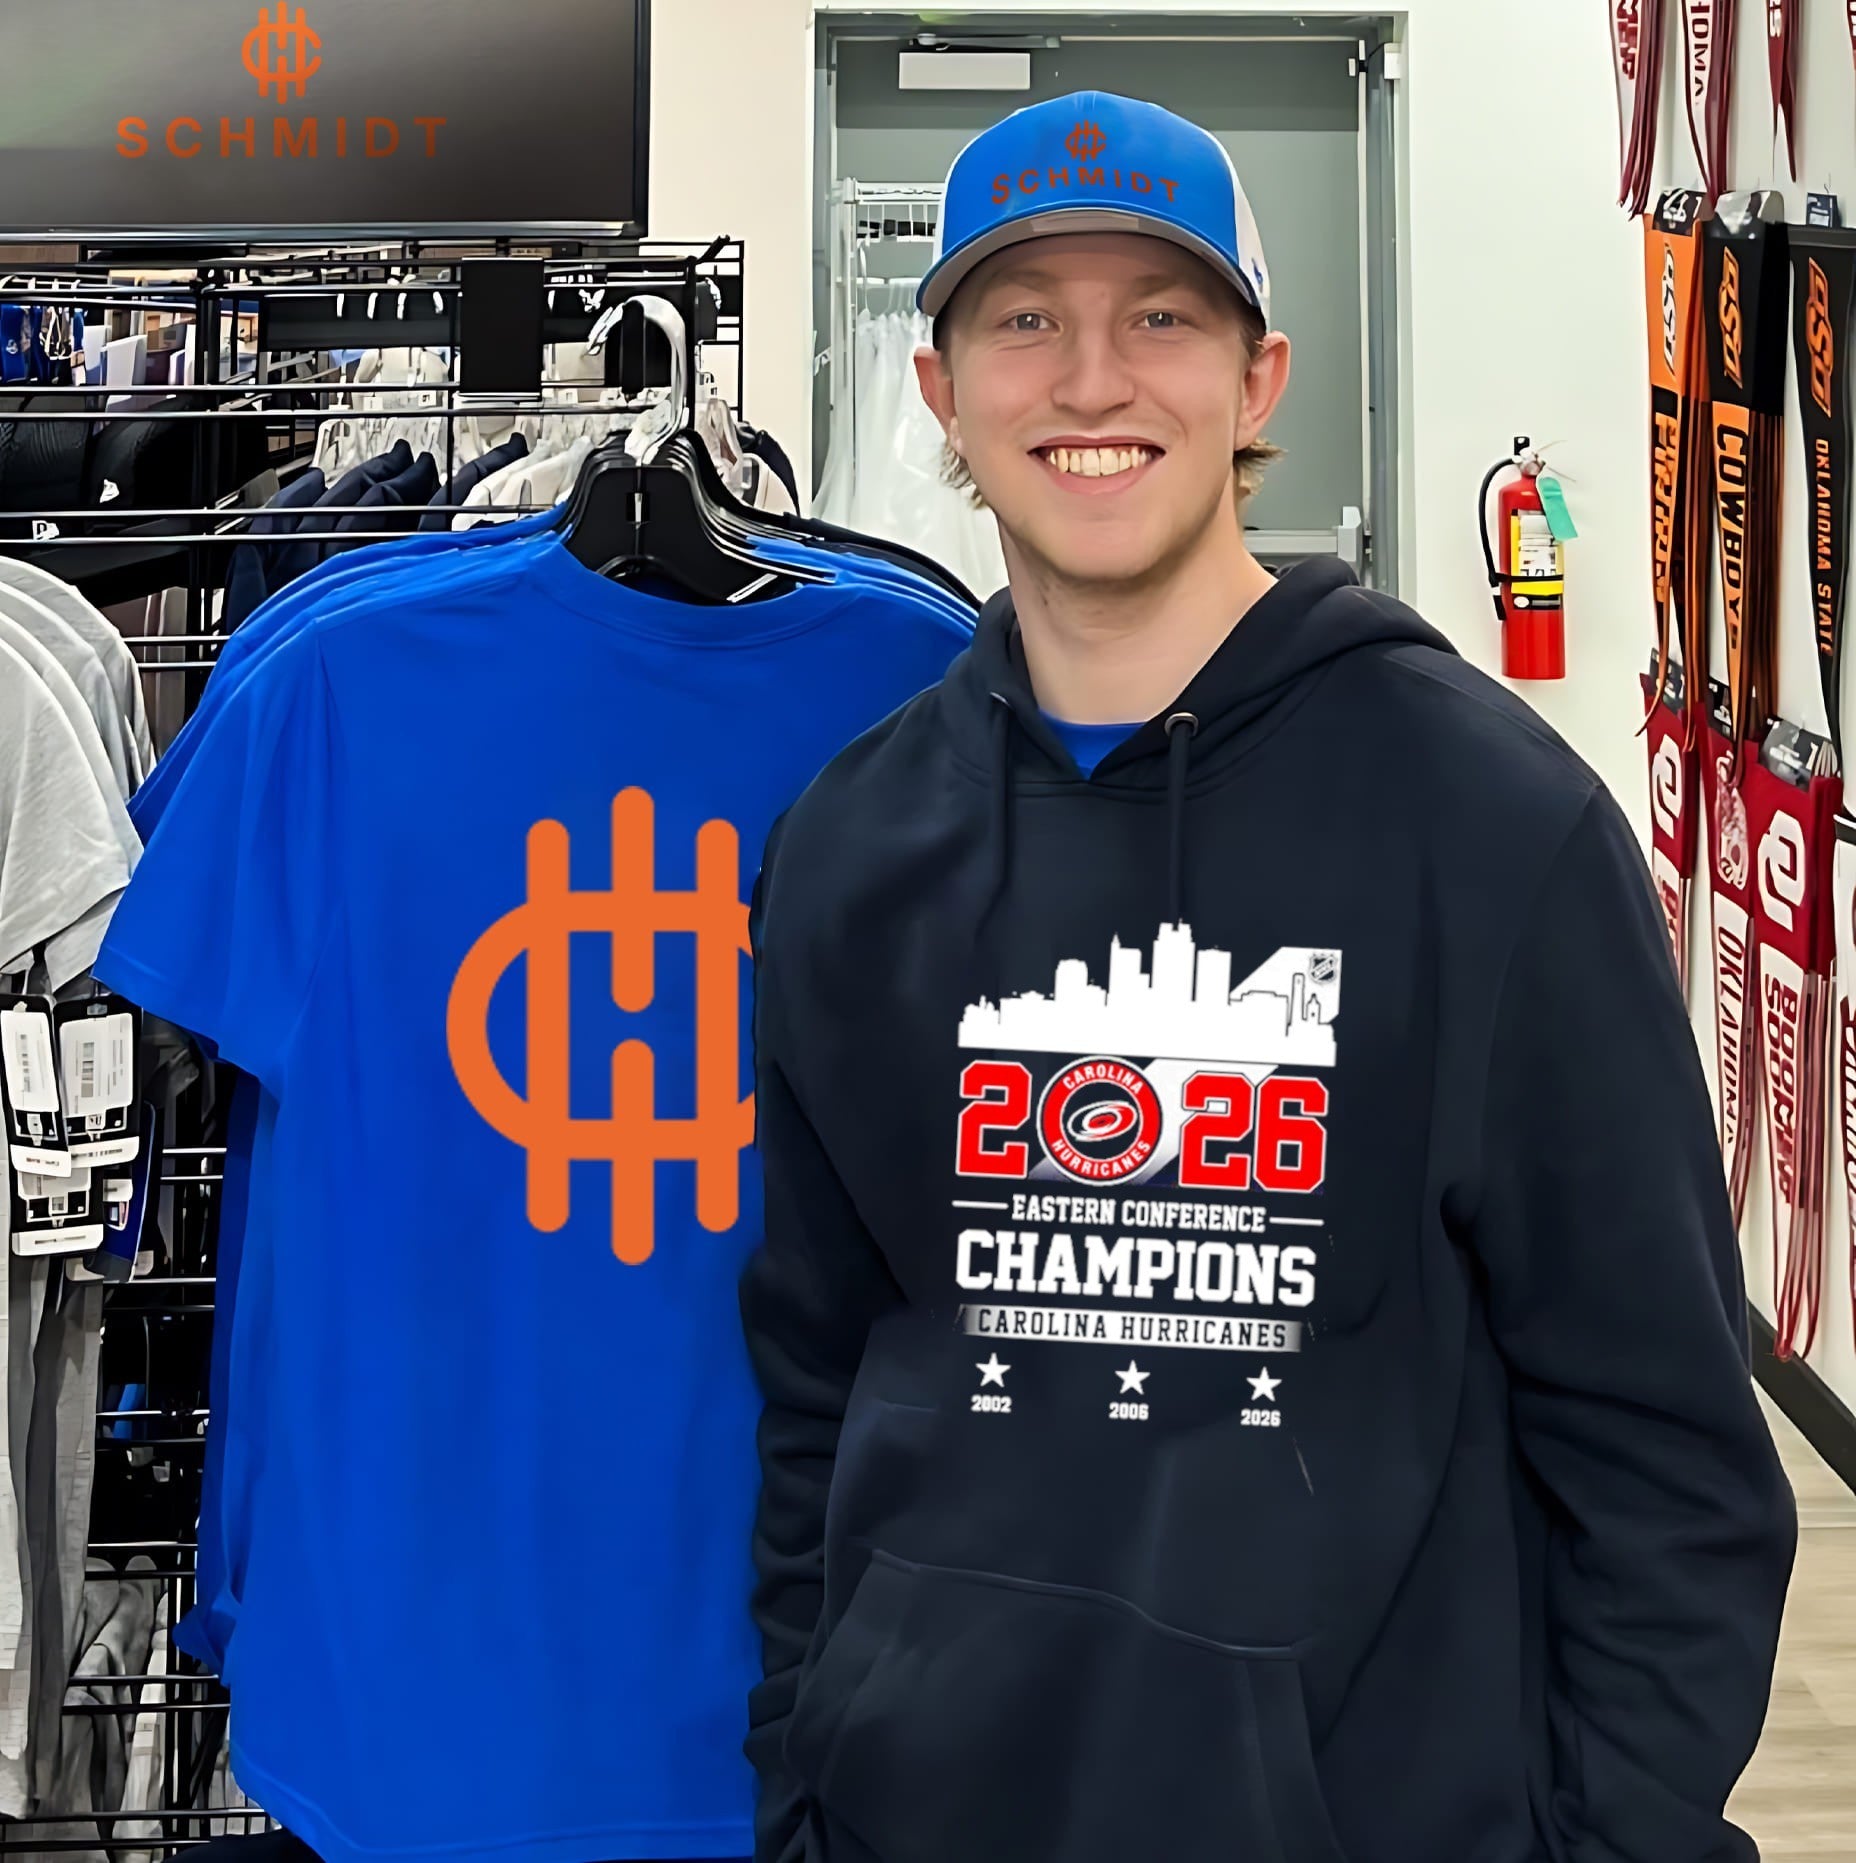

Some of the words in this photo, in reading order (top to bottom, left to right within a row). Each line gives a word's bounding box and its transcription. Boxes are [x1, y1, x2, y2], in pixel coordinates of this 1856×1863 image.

[115, 116, 447, 158] SCHMIDT
[991, 167, 1179, 205] SCHMIDT
[1815, 438, 1832, 570] OKLAHOMA
[1717, 926, 1744, 1144] OKLAHOMA
[1062, 1063, 1144, 1095] CAROLINA
[1052, 1139, 1151, 1177] HURRICANES
[1012, 1194, 1115, 1225] EASTERN
[1121, 1198, 1266, 1233] CONFERENCE
[955, 1229, 1316, 1307] CHAMPIONS
[978, 1309, 1107, 1339] CAROLINA
[1120, 1316, 1286, 1348] HURRICANES
[971, 1395, 1012, 1413] 2002
[1109, 1402, 1149, 1421] 2006
[1240, 1409, 1281, 1427] 2026
